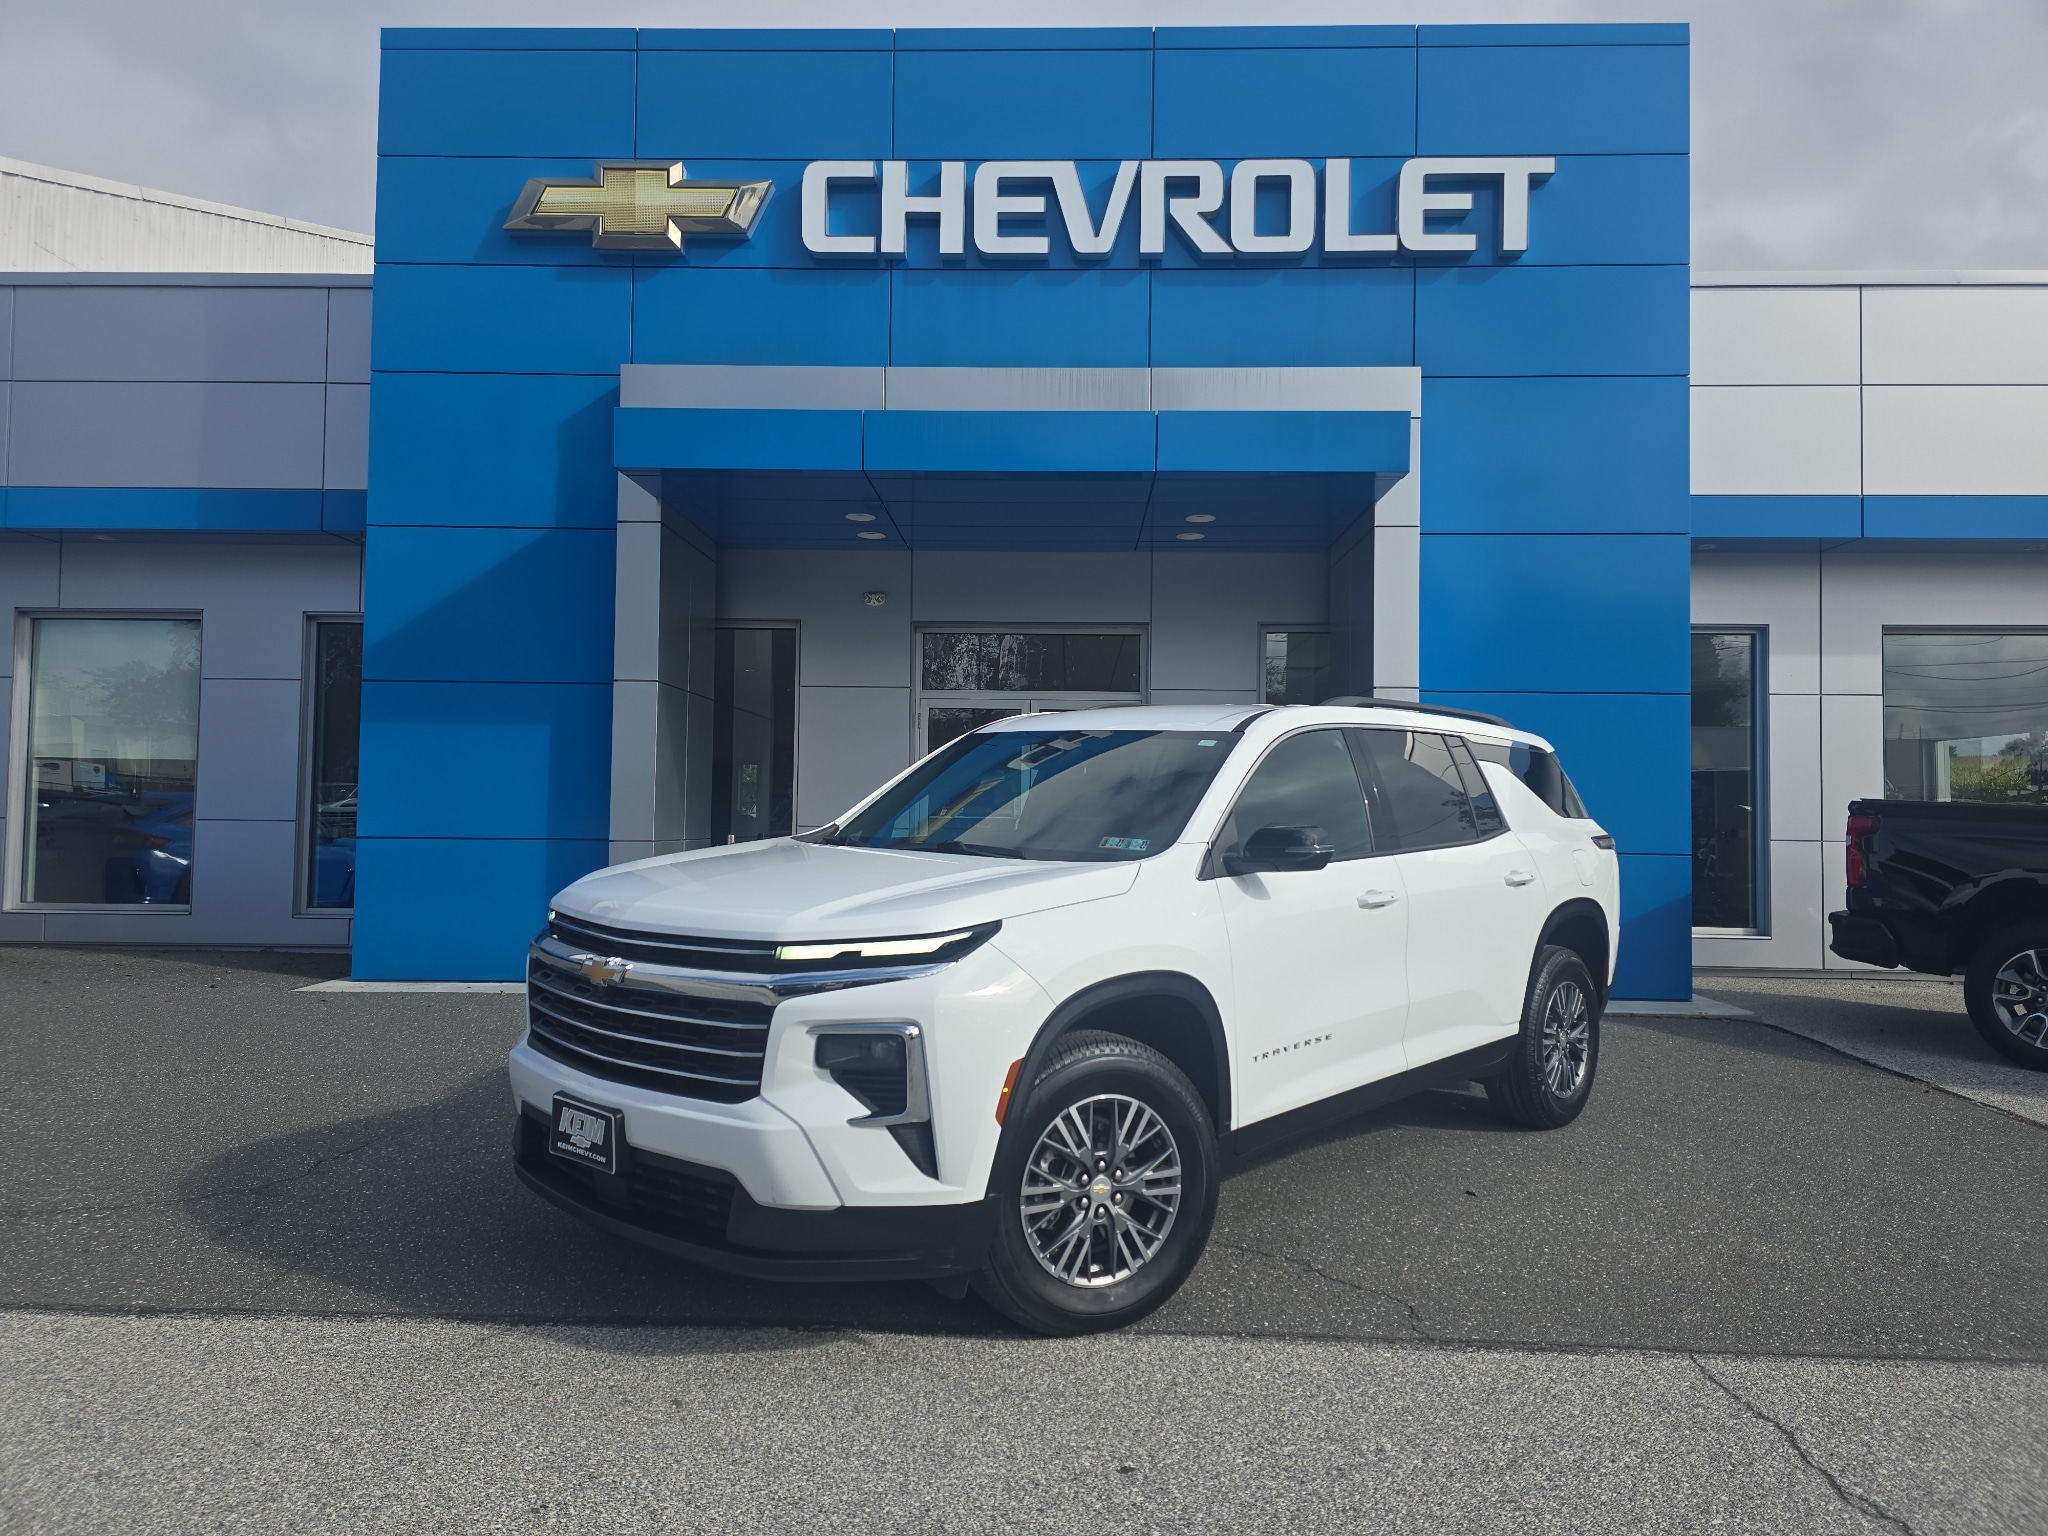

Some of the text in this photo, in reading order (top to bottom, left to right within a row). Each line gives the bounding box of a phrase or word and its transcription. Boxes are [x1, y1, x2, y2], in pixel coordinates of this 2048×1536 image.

[801, 157, 1557, 256] CHEVROLET
[1252, 1033, 1333, 1063] TRAVERSE
[558, 1106, 606, 1146] KEIM
[557, 1141, 606, 1164] KEIMCHEVY.COM
